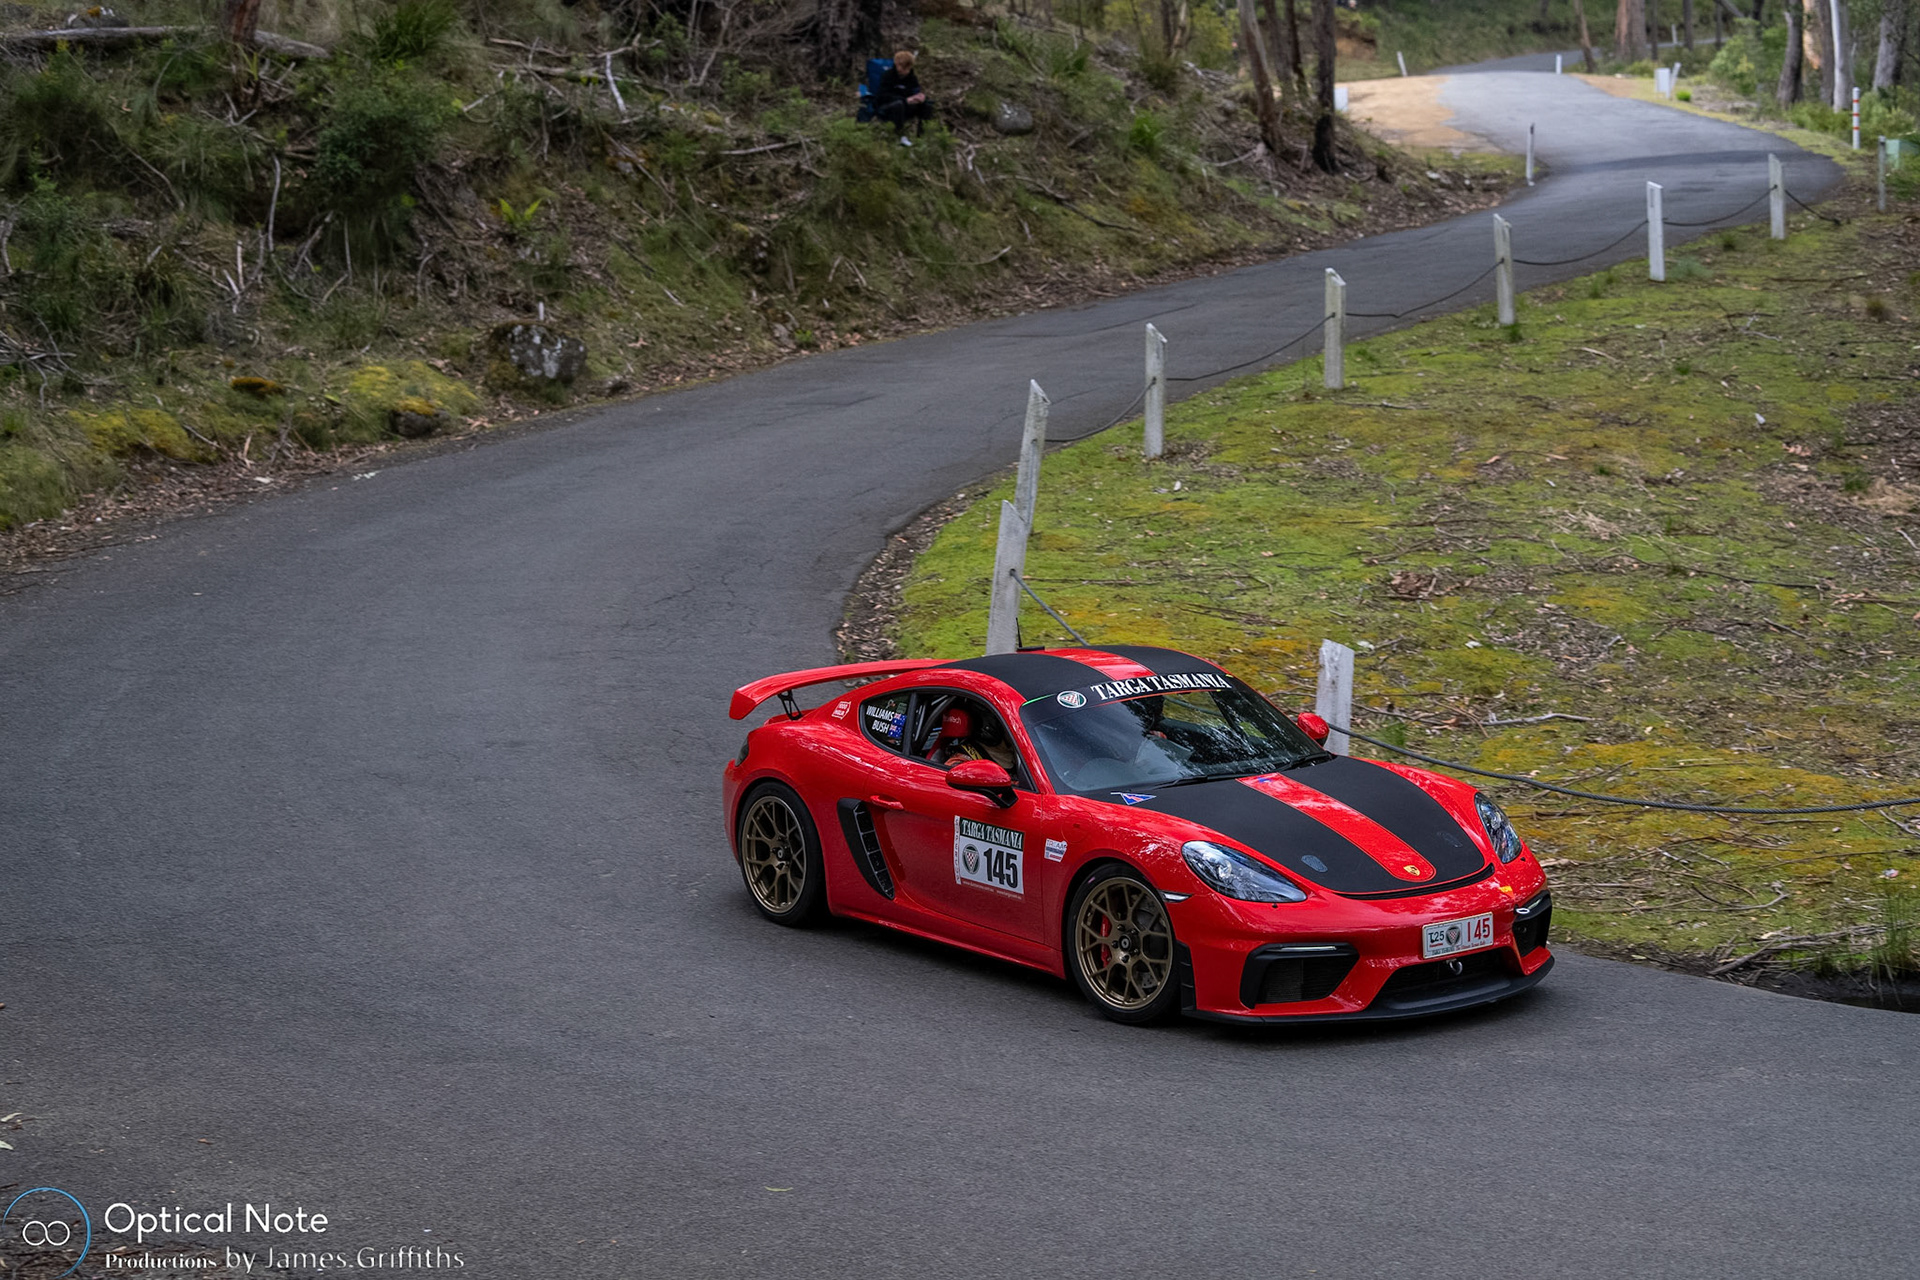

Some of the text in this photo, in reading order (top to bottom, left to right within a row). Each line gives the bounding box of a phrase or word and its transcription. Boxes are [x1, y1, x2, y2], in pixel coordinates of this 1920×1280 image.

[1090, 673, 1233, 701] TARGA TASMANIA
[866, 705, 895, 721] WILLIAMS
[871, 719, 890, 733] BUSH
[961, 819, 1023, 850] TARGA TASMANIA
[983, 847, 1018, 889] 145
